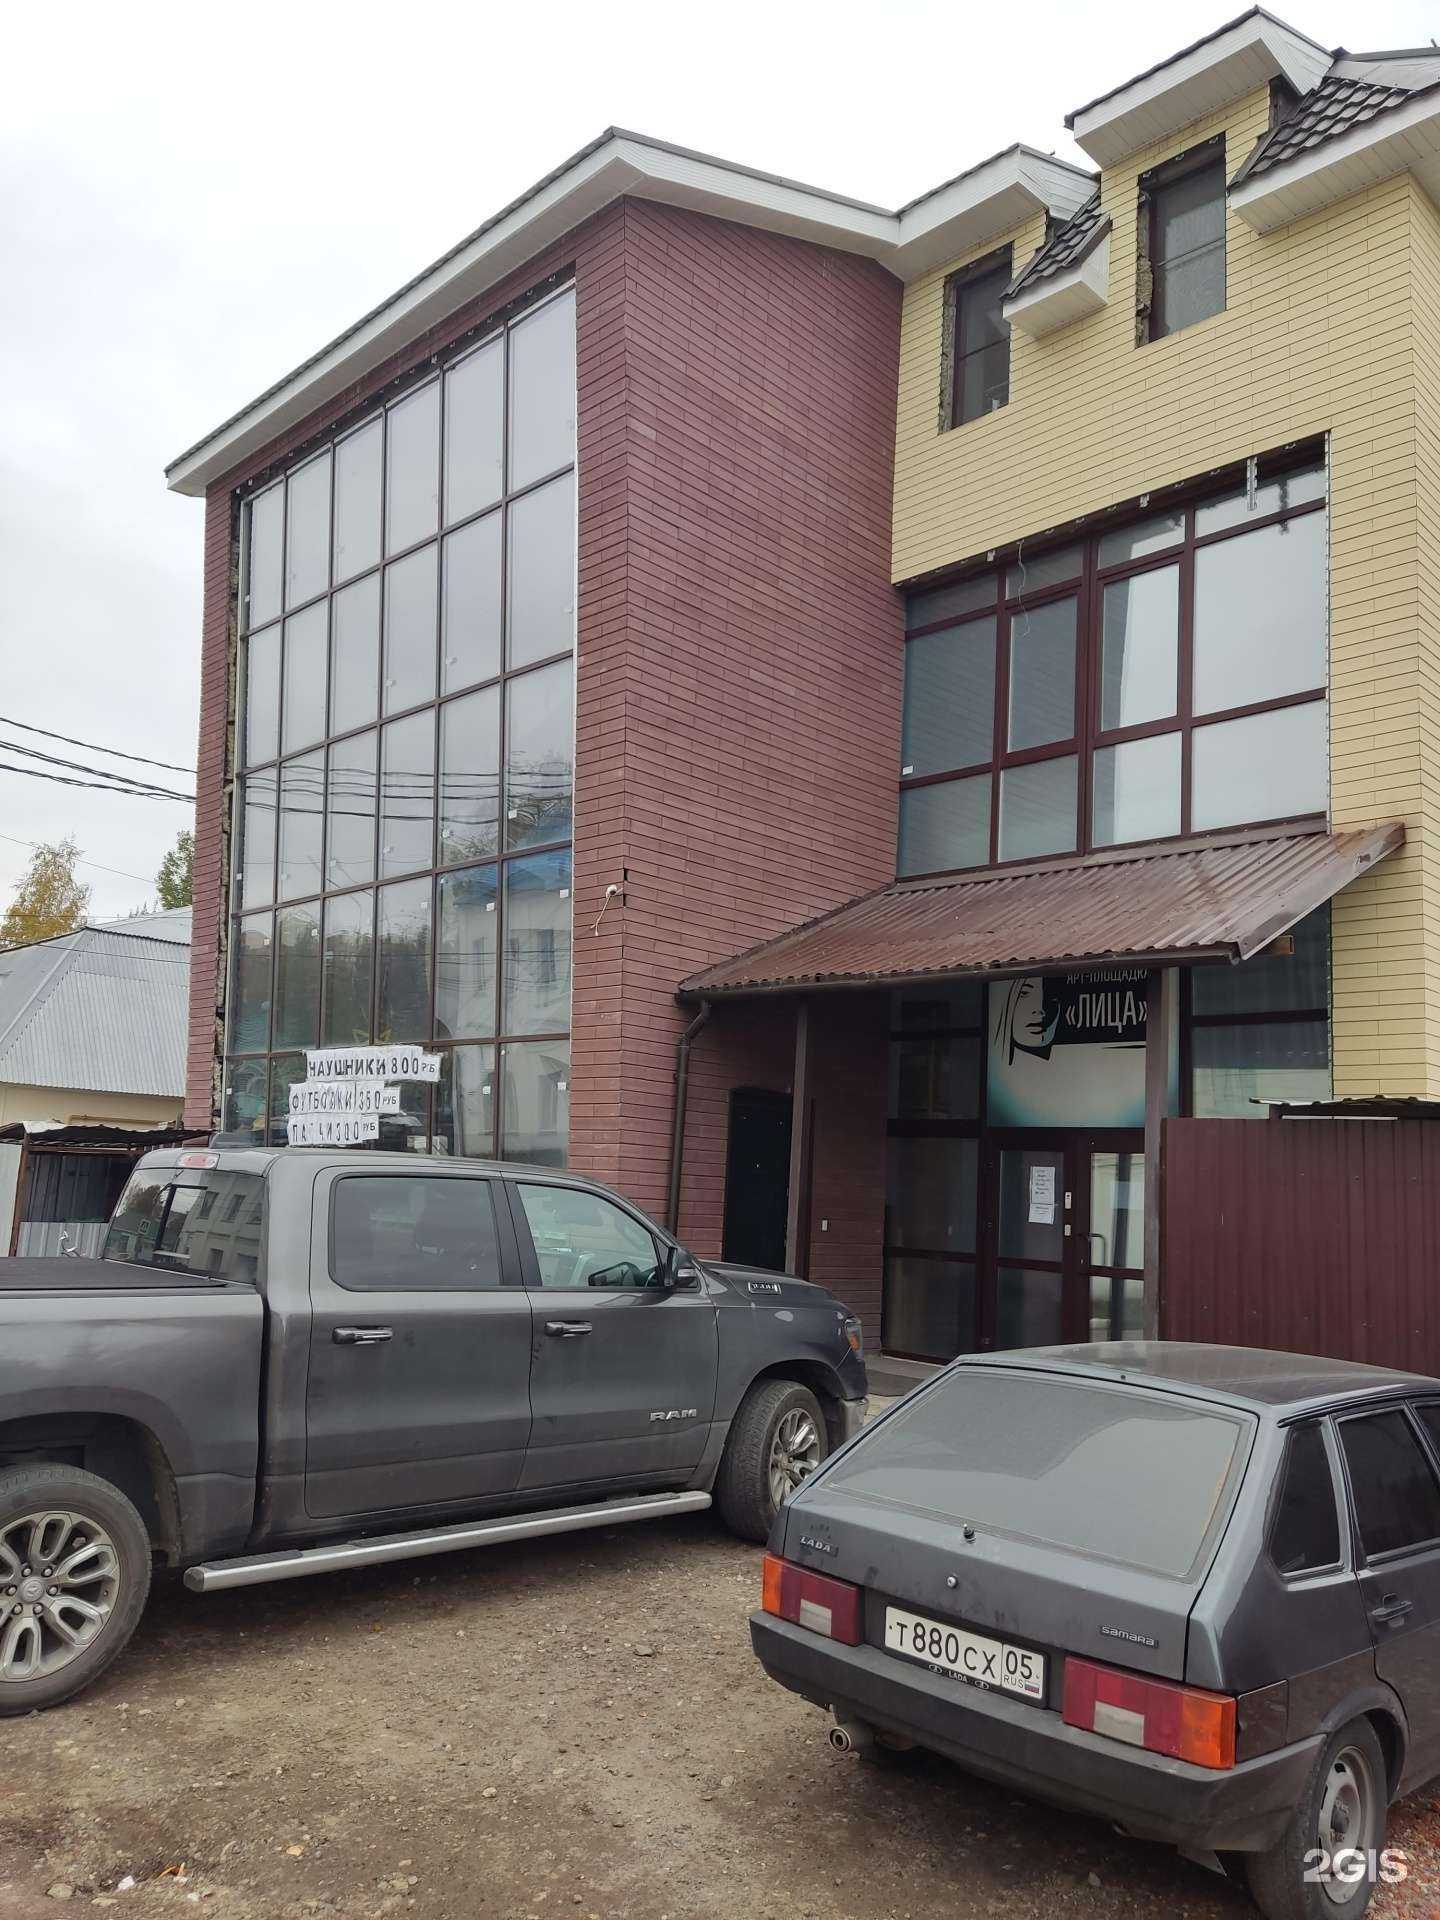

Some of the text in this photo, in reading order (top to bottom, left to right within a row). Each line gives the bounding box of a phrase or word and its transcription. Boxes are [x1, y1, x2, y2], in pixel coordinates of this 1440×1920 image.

[1065, 990, 1148, 1034] «ЛИЦА»
[308, 1057, 386, 1078] НАУШНИКИ
[391, 1057, 419, 1075] 800
[292, 1122, 333, 1143] ПАЧИ
[649, 1408, 697, 1422] RAM
[800, 1536, 831, 1553] LADA
[1005, 1650, 1033, 1680] 05
[947, 1669, 968, 1684] LADA
[1003, 1675, 1024, 1689] RUS
